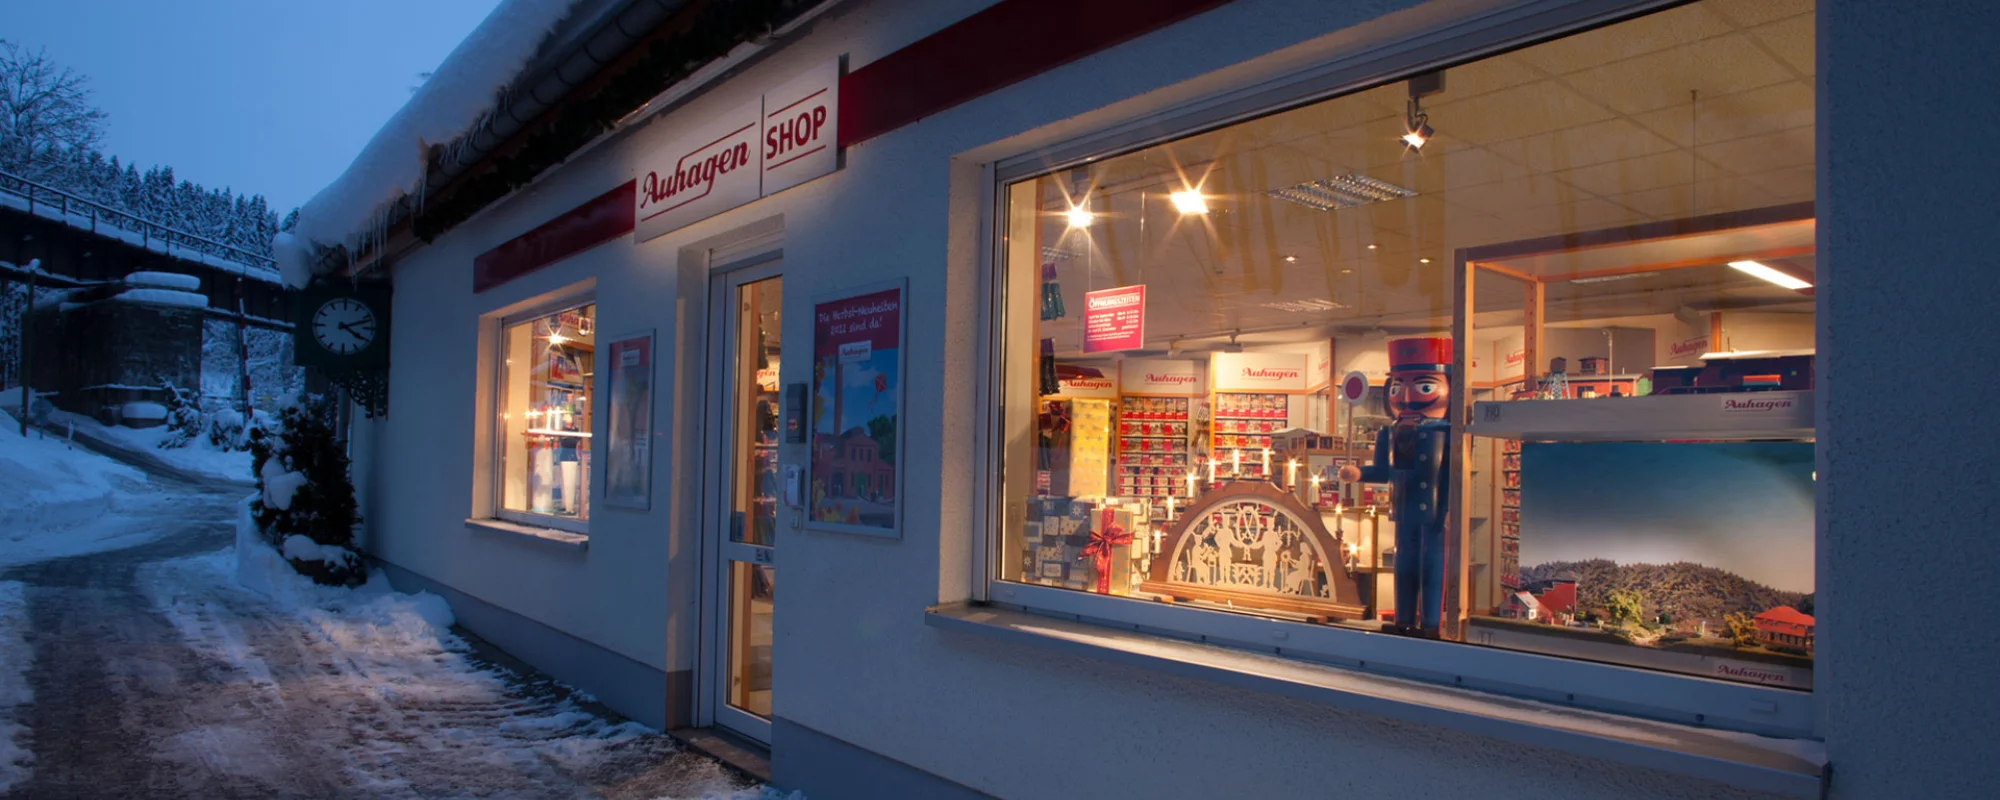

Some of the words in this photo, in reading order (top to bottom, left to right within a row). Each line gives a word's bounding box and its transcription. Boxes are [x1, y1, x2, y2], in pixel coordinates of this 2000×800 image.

[766, 105, 827, 160] SHOP
[640, 141, 751, 209] Auhagen
[1670, 337, 1708, 355] Auhagen
[1145, 373, 1197, 384] Auhagen
[1241, 367, 1298, 380] Auhagen
[1064, 379, 1112, 389] Auhagen
[1725, 398, 1792, 411] Auhagen
[1716, 663, 1785, 683] Auhagen
